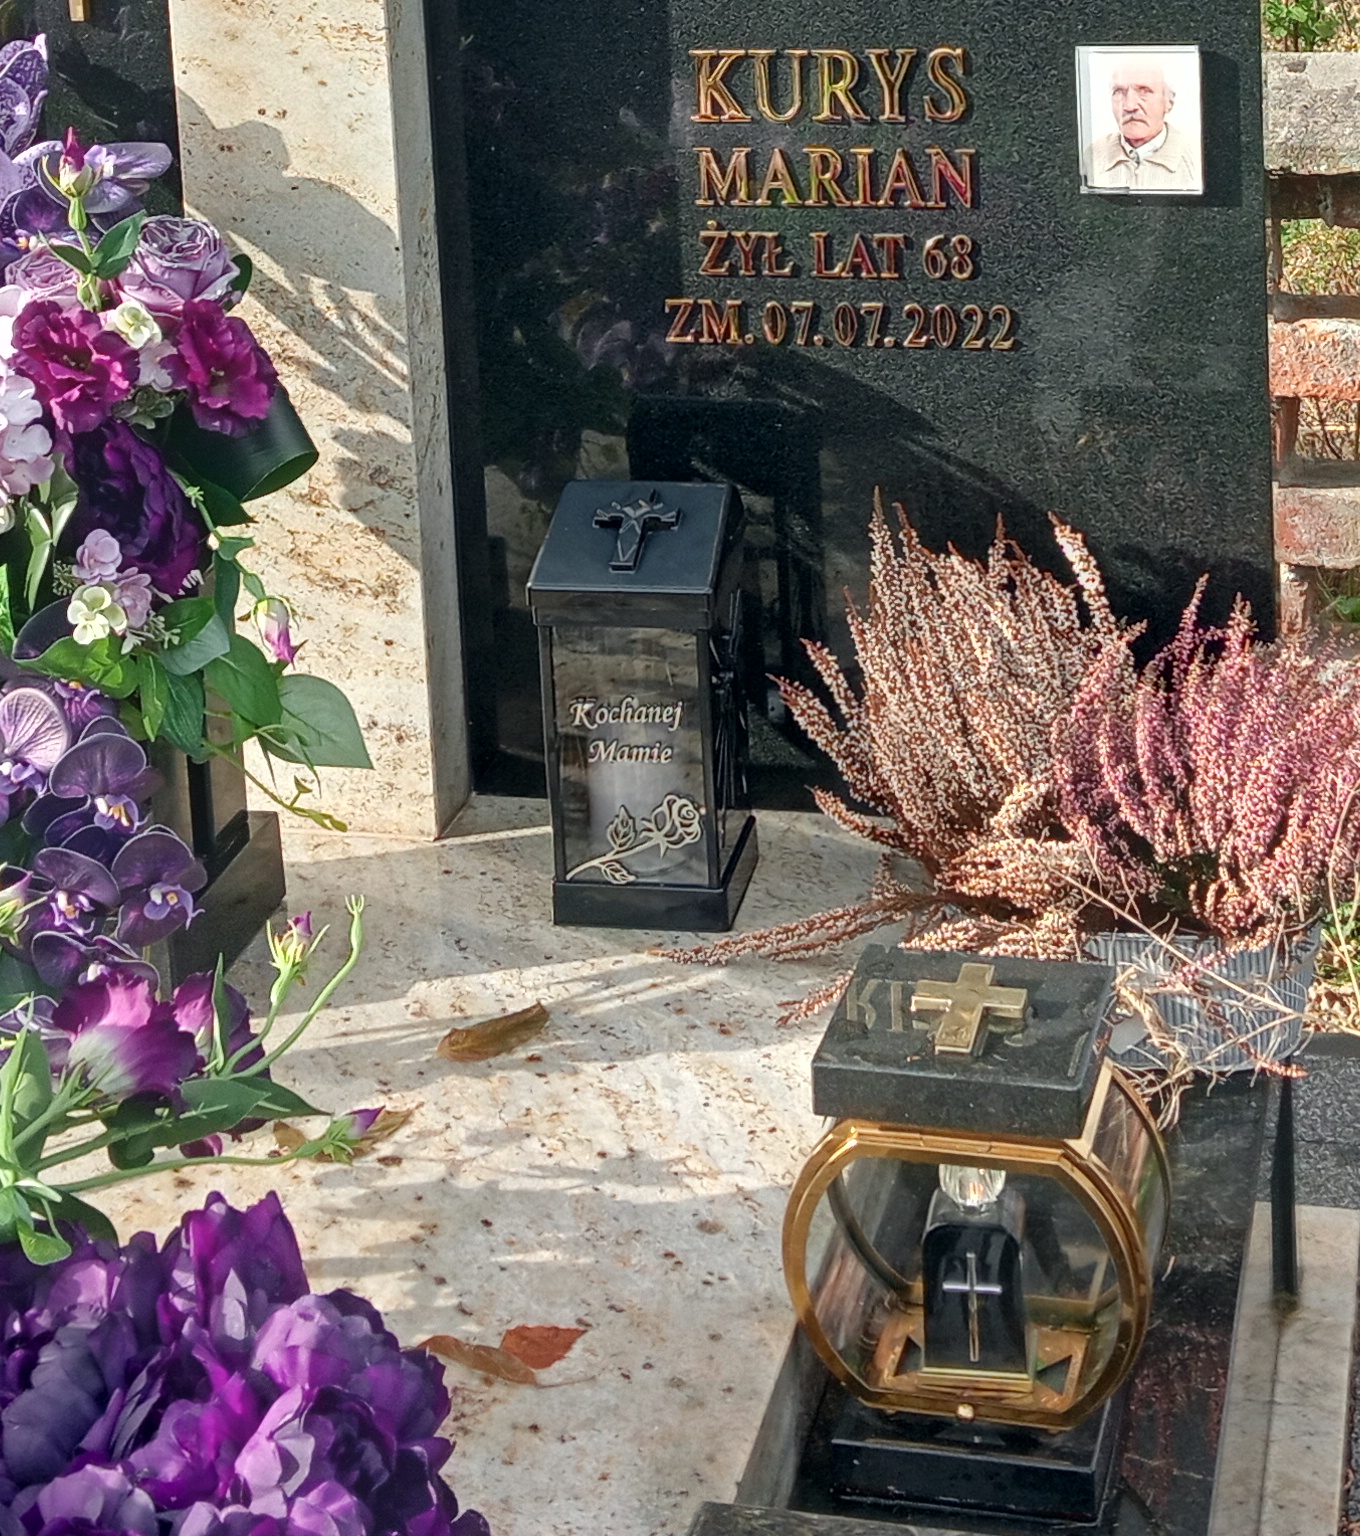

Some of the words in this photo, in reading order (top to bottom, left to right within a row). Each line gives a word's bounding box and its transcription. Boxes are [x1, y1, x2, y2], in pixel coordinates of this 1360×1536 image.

[688, 46, 968, 124] KURYS
[693, 144, 977, 209] MARIAN
[698, 220, 794, 277] ŻYŁ
[809, 231, 906, 279] LAT
[922, 233, 975, 280] 68
[568, 696, 684, 732] Kochanej
[587, 738, 673, 766] Mamie
